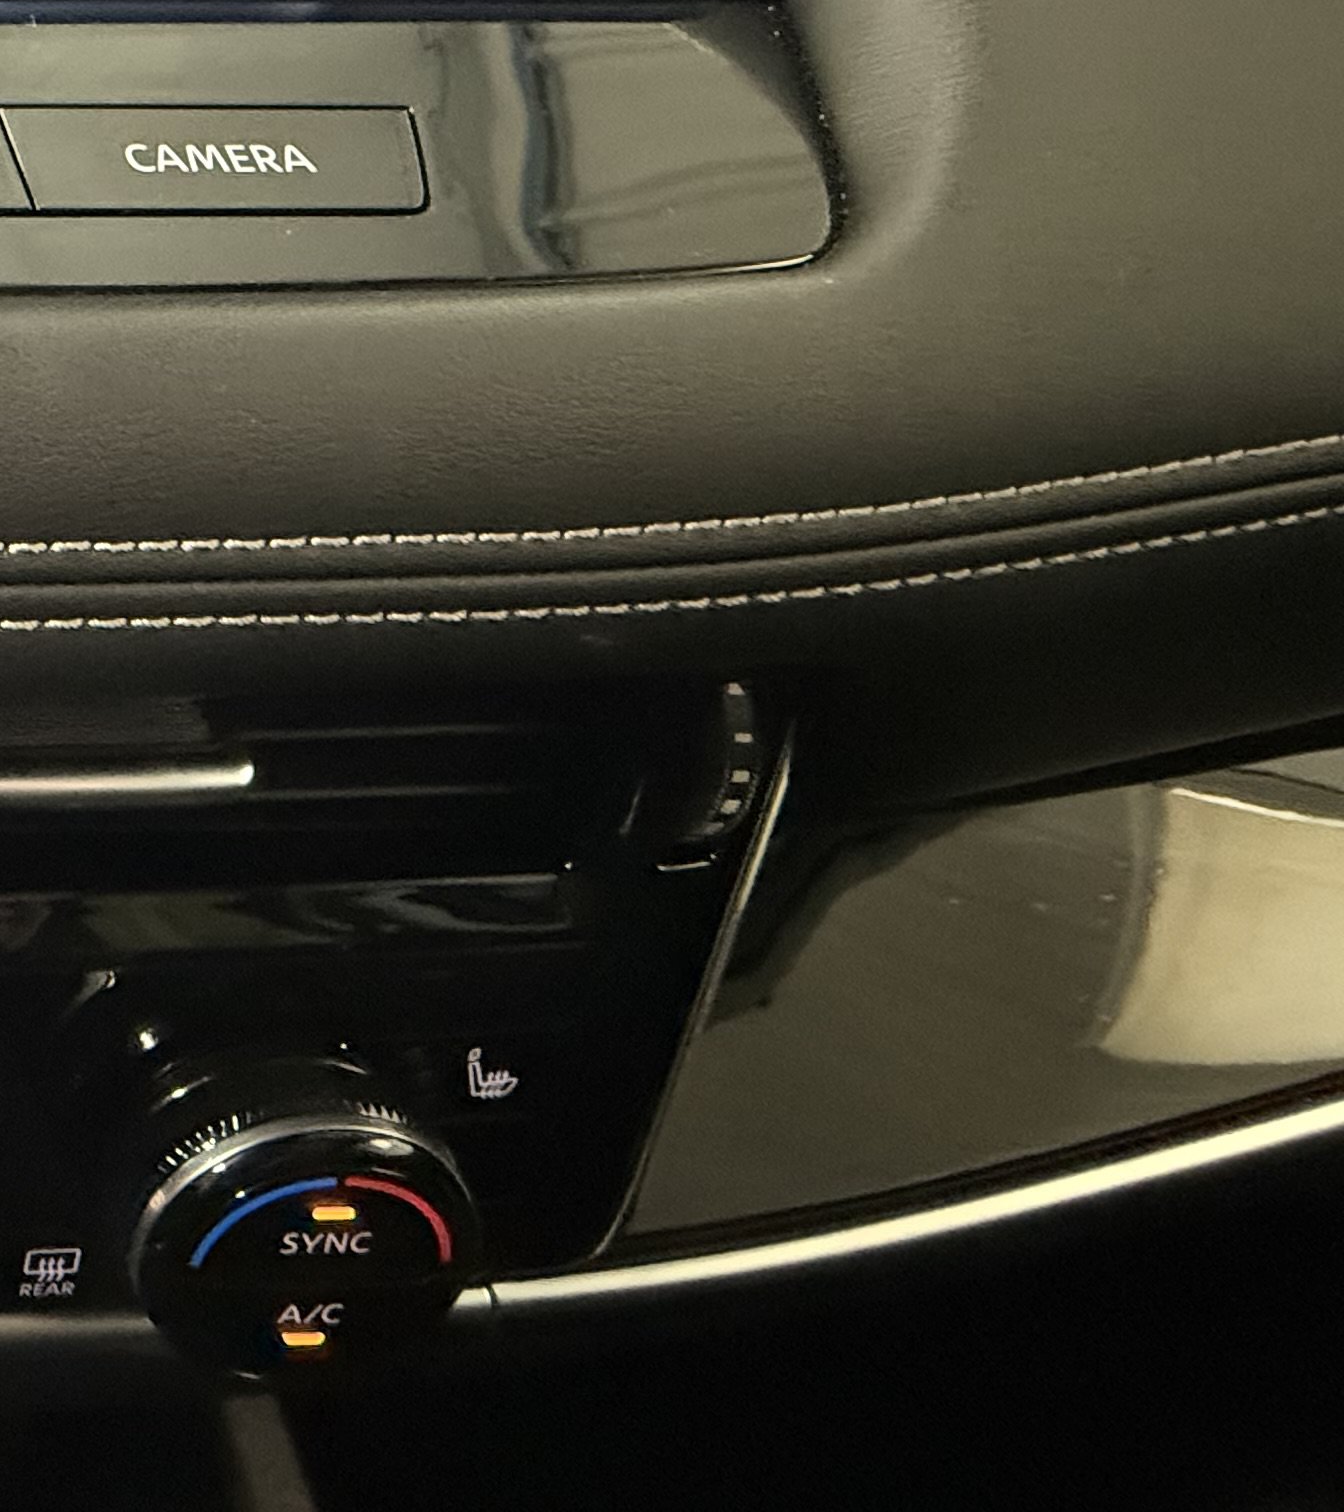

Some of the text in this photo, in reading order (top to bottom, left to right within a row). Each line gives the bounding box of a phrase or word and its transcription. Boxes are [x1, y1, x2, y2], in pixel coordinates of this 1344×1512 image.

[124, 142, 318, 175] CAMERA
[279, 1231, 373, 1256] SYNC
[19, 1282, 75, 1298] REAR
[278, 1303, 344, 1325] A/C
